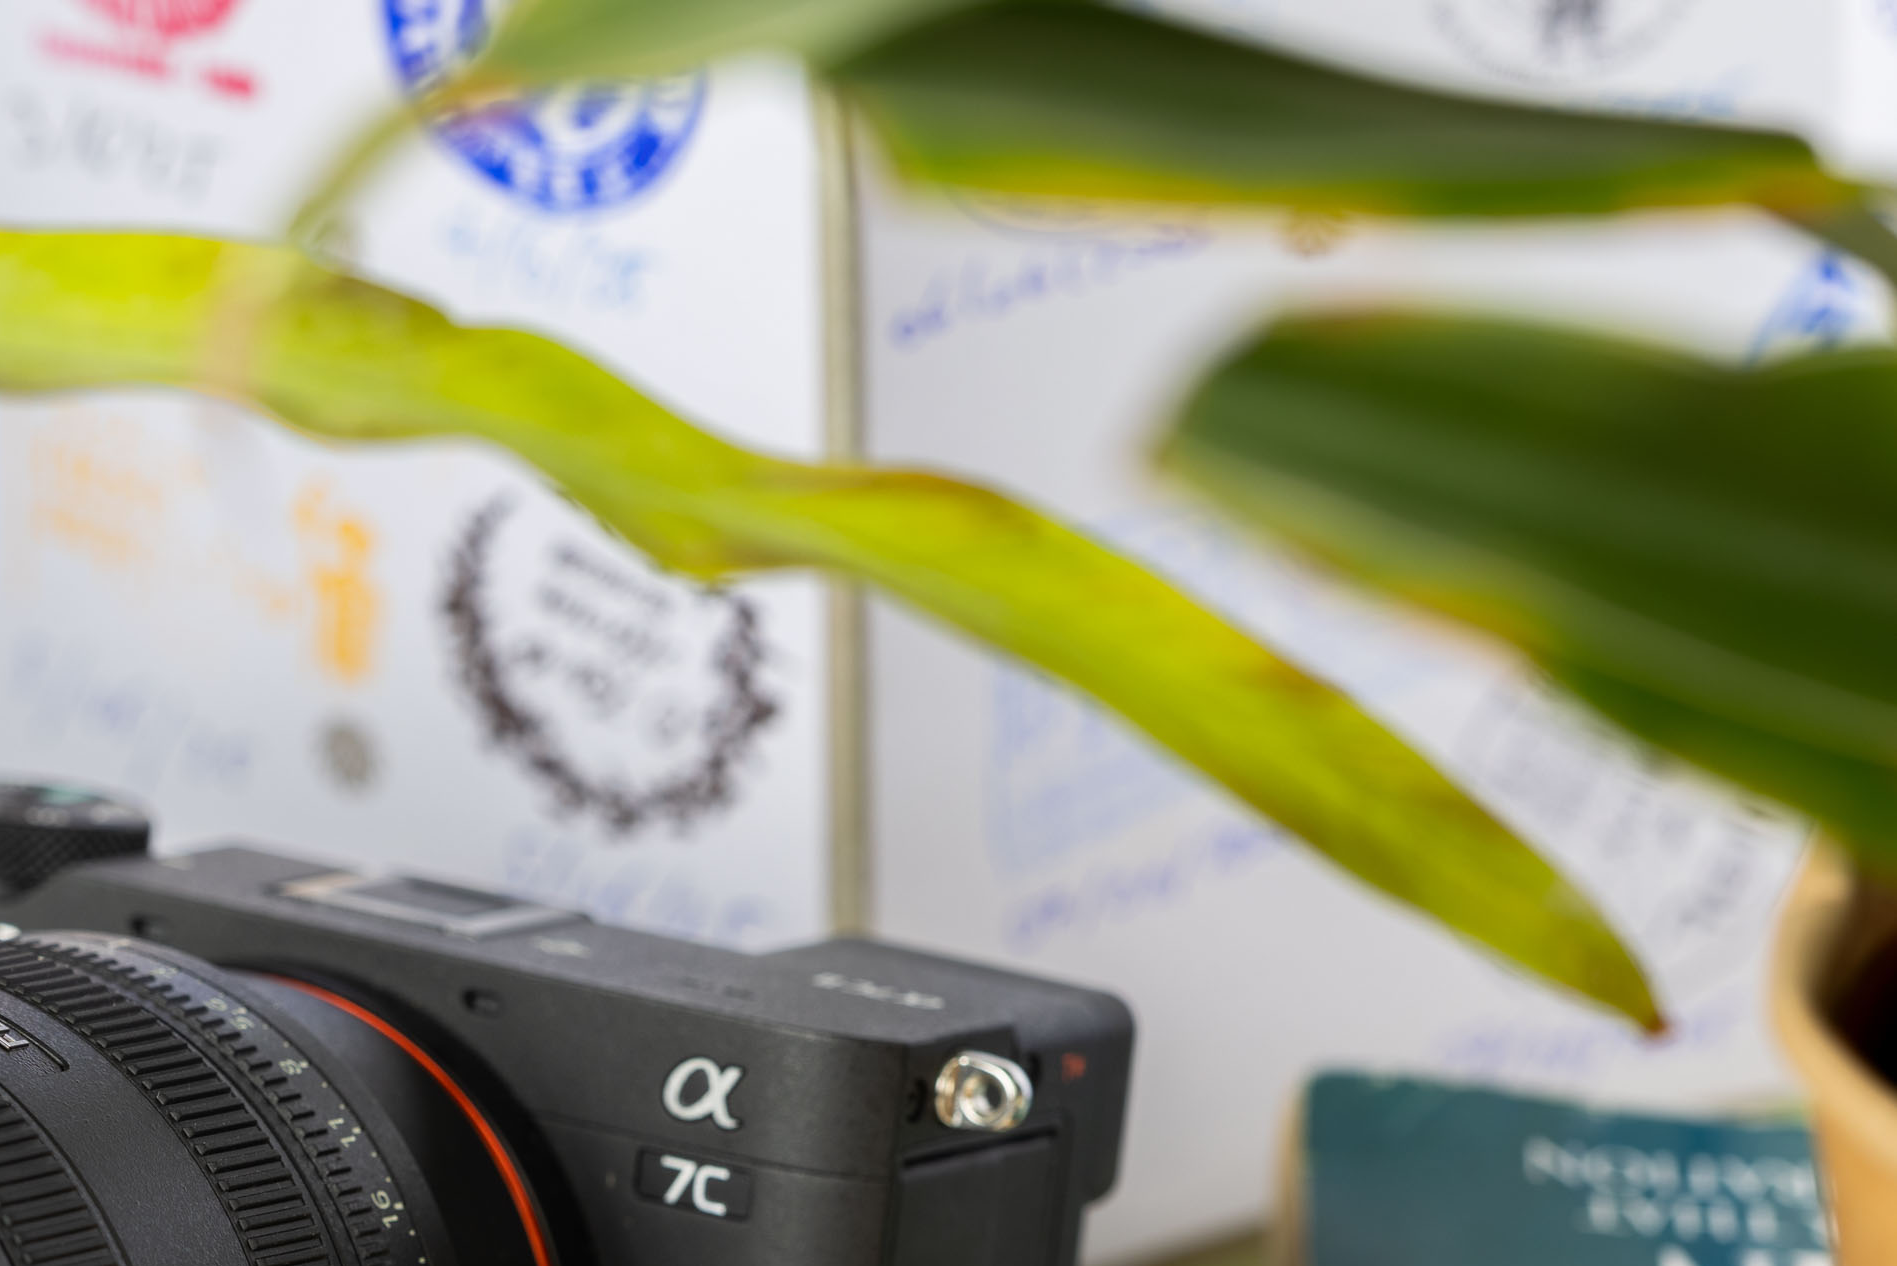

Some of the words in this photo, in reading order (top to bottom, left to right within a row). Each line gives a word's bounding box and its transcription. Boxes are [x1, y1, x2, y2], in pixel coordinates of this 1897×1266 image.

[328, 1118, 356, 1148] 11
[661, 1154, 731, 1217] 7C
[371, 1190, 399, 1228] 16
